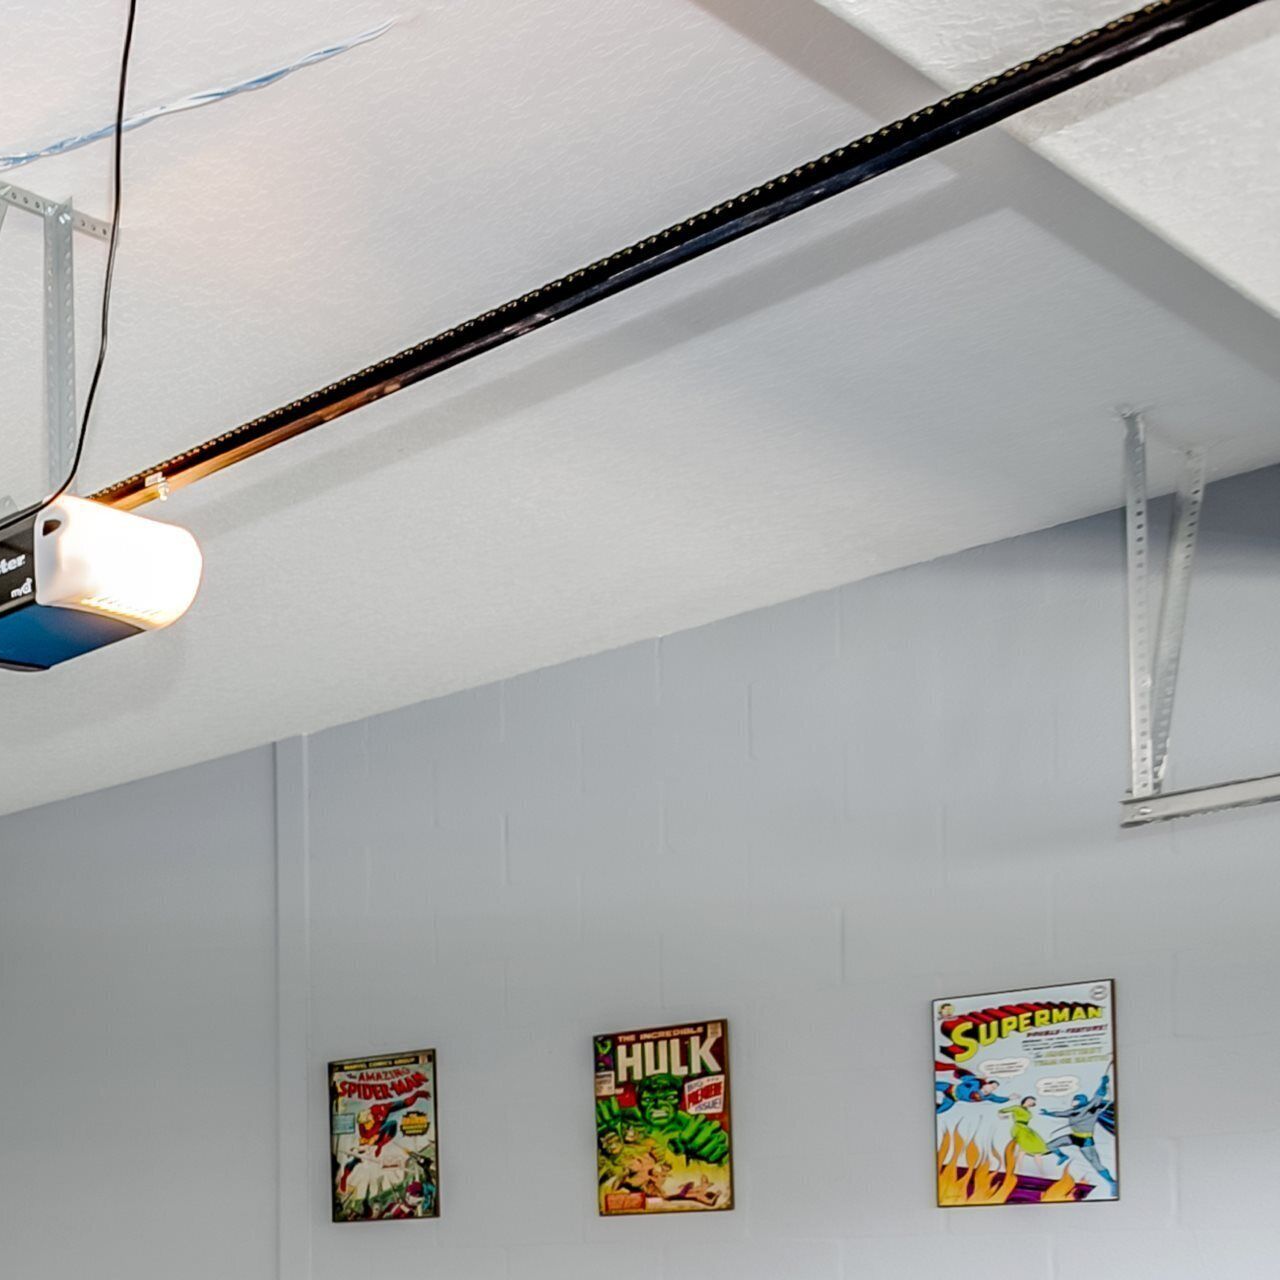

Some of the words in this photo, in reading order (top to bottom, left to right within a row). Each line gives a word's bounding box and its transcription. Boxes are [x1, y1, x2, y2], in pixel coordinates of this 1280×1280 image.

[640, 1026, 705, 1041] INCREDIBLE
[948, 1006, 1103, 1063] SUPERMAN
[617, 1027, 723, 1082] HULK
[340, 1071, 429, 1100] SPIDER-MAN
[359, 1067, 411, 1081] AMAZING
